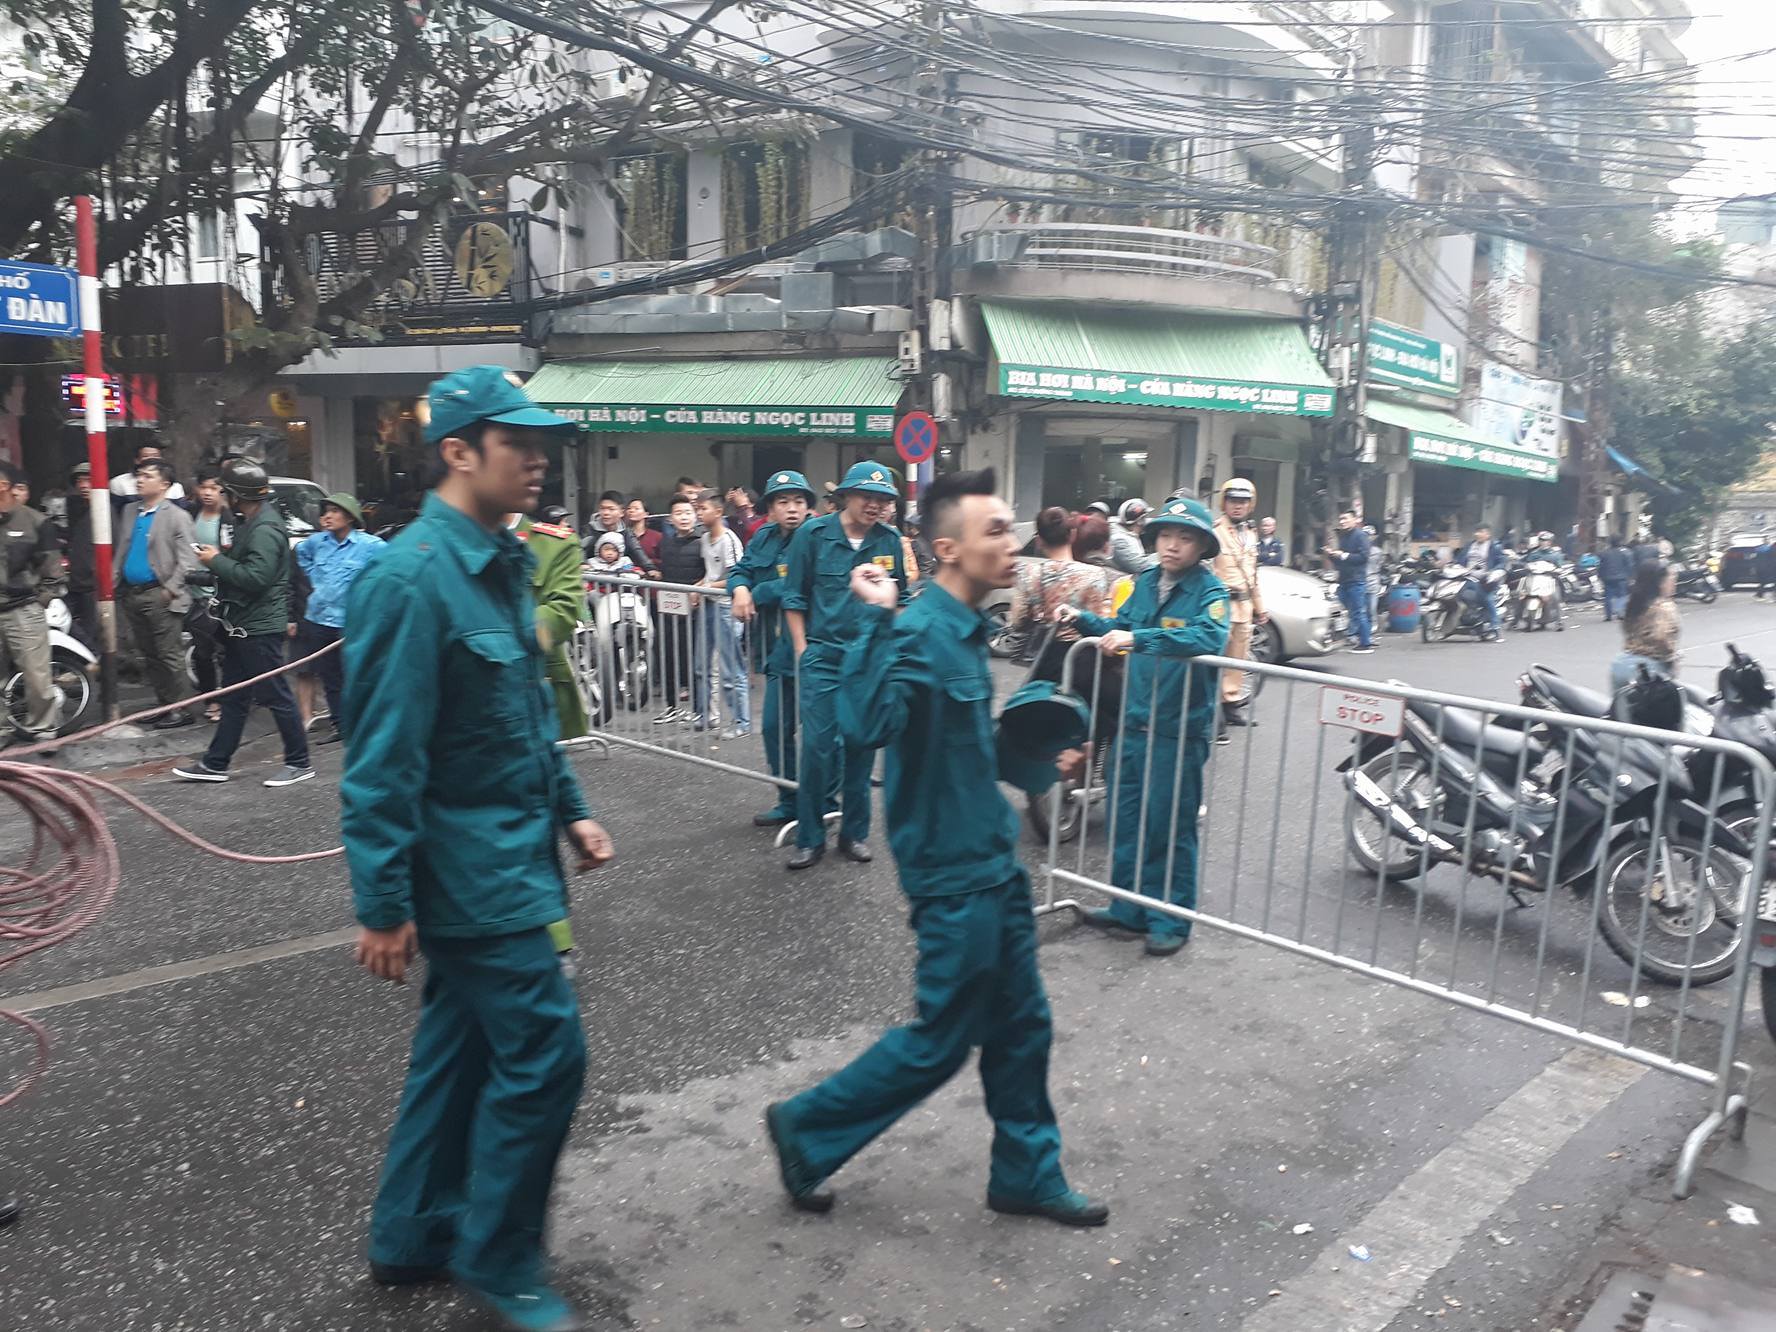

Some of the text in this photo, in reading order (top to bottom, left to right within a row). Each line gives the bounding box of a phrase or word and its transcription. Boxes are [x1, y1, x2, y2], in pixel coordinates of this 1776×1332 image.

[7, 293, 68, 324] ĐÀN
[587, 407, 613, 422] HÀ
[614, 407, 648, 425] NỘI
[701, 408, 750, 425] HÀNG
[754, 411, 806, 428] NGỌC
[809, 412, 856, 426] LINH
[1337, 705, 1384, 723] STOP
